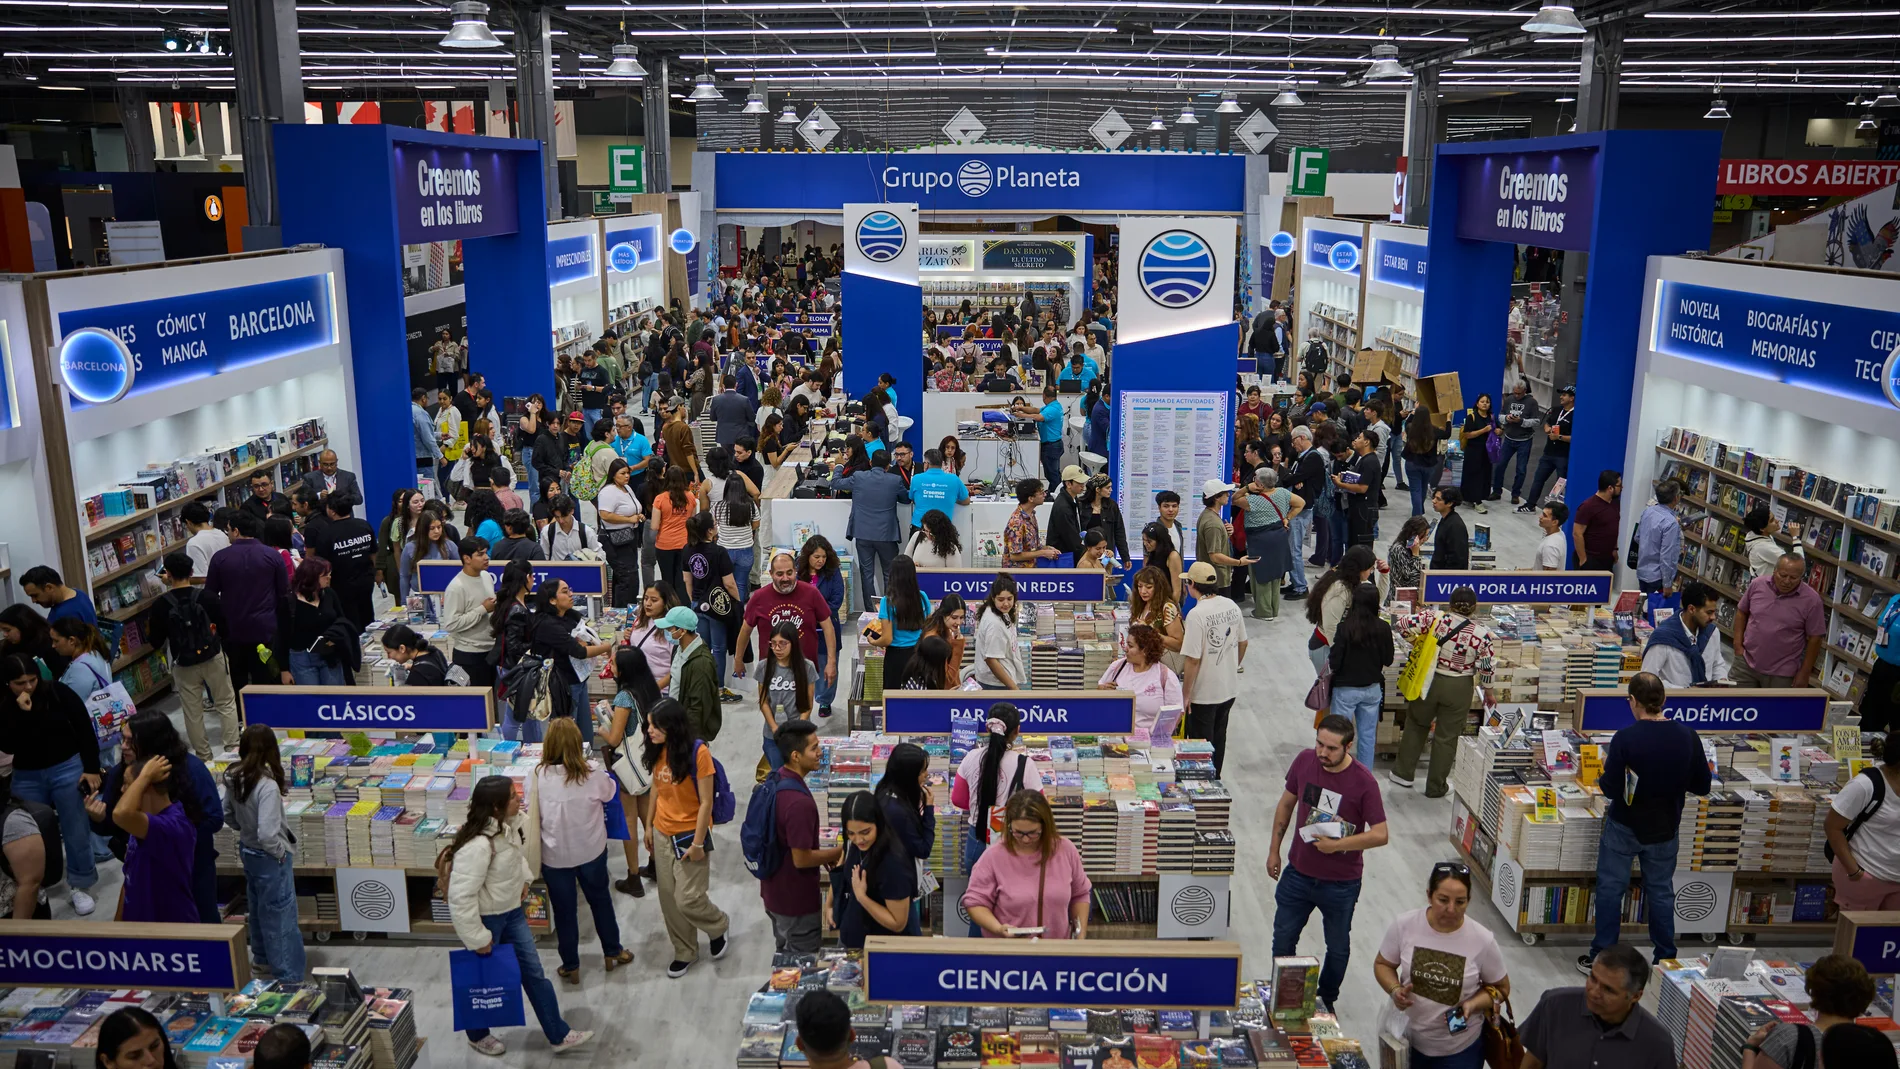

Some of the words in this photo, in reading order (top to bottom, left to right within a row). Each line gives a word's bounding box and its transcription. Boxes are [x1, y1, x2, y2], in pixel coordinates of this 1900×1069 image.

[418, 159, 480, 196] Creemos
[613, 149, 636, 186] E
[1298, 151, 1322, 189] F
[1726, 164, 1808, 184] LIBROS
[882, 166, 953, 194] Grupo
[996, 165, 1080, 187] Planeta
[1500, 165, 1568, 202] Creemos
[420, 206, 434, 227] en
[436, 200, 453, 226] los
[454, 200, 482, 224] libros
[1496, 208, 1510, 228] en
[1512, 204, 1528, 229] los
[1530, 206, 1565, 233] libros
[556, 250, 592, 268] IMPRESCINDIBLES
[925, 256, 961, 266] ZAFÓN
[1384, 254, 1397, 268] ESTAR
[1397, 258, 1408, 270] BIEN
[229, 300, 315, 340] BARCELONA
[1680, 299, 1720, 320] NOVELA
[156, 313, 196, 338] CÓMIC
[198, 312, 206, 330] Y
[1671, 322, 1724, 348] HISTÓRICA
[1747, 310, 1818, 338] BIOGRAFÍAS
[1821, 322, 1831, 340] Y
[162, 340, 207, 366] MANGA
[1751, 339, 1816, 368] MEMORIAS
[64, 360, 125, 372] BARCELONA
[334, 534, 372, 550] ALLSAINTS
[944, 581, 962, 592] LO
[1031, 582, 1074, 592] REDES
[1479, 584, 1507, 594] POR
[1510, 584, 1527, 594] LA
[1530, 584, 1598, 595] HISTORIA
[769, 676, 796, 691] Lee
[318, 701, 416, 721] CLÁSICOS
[938, 970, 1048, 991] CIENCIA
[1055, 968, 1167, 992] FICCIÓN
[1412, 970, 1460, 986] COACH
[987, 1043, 1014, 1055] 451
[1067, 1046, 1099, 1056] MICKEY
